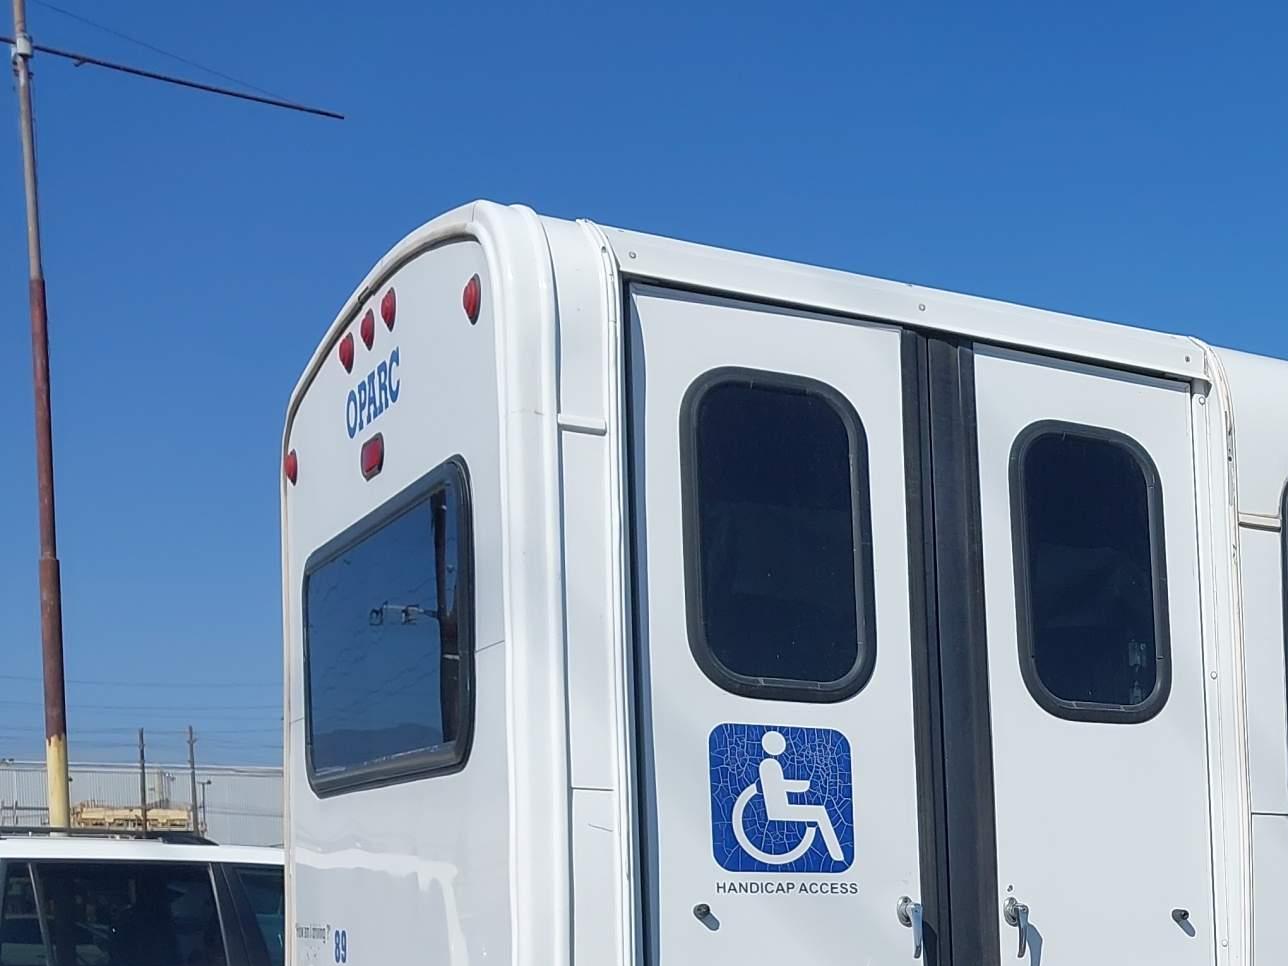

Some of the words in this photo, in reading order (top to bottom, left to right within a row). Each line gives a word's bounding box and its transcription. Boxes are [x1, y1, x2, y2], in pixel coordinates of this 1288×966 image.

[346, 346, 400, 439] OPARC
[716, 882, 795, 894] HANDICAP
[799, 882, 858, 894] ACCESS
[335, 929, 347, 963] 89
